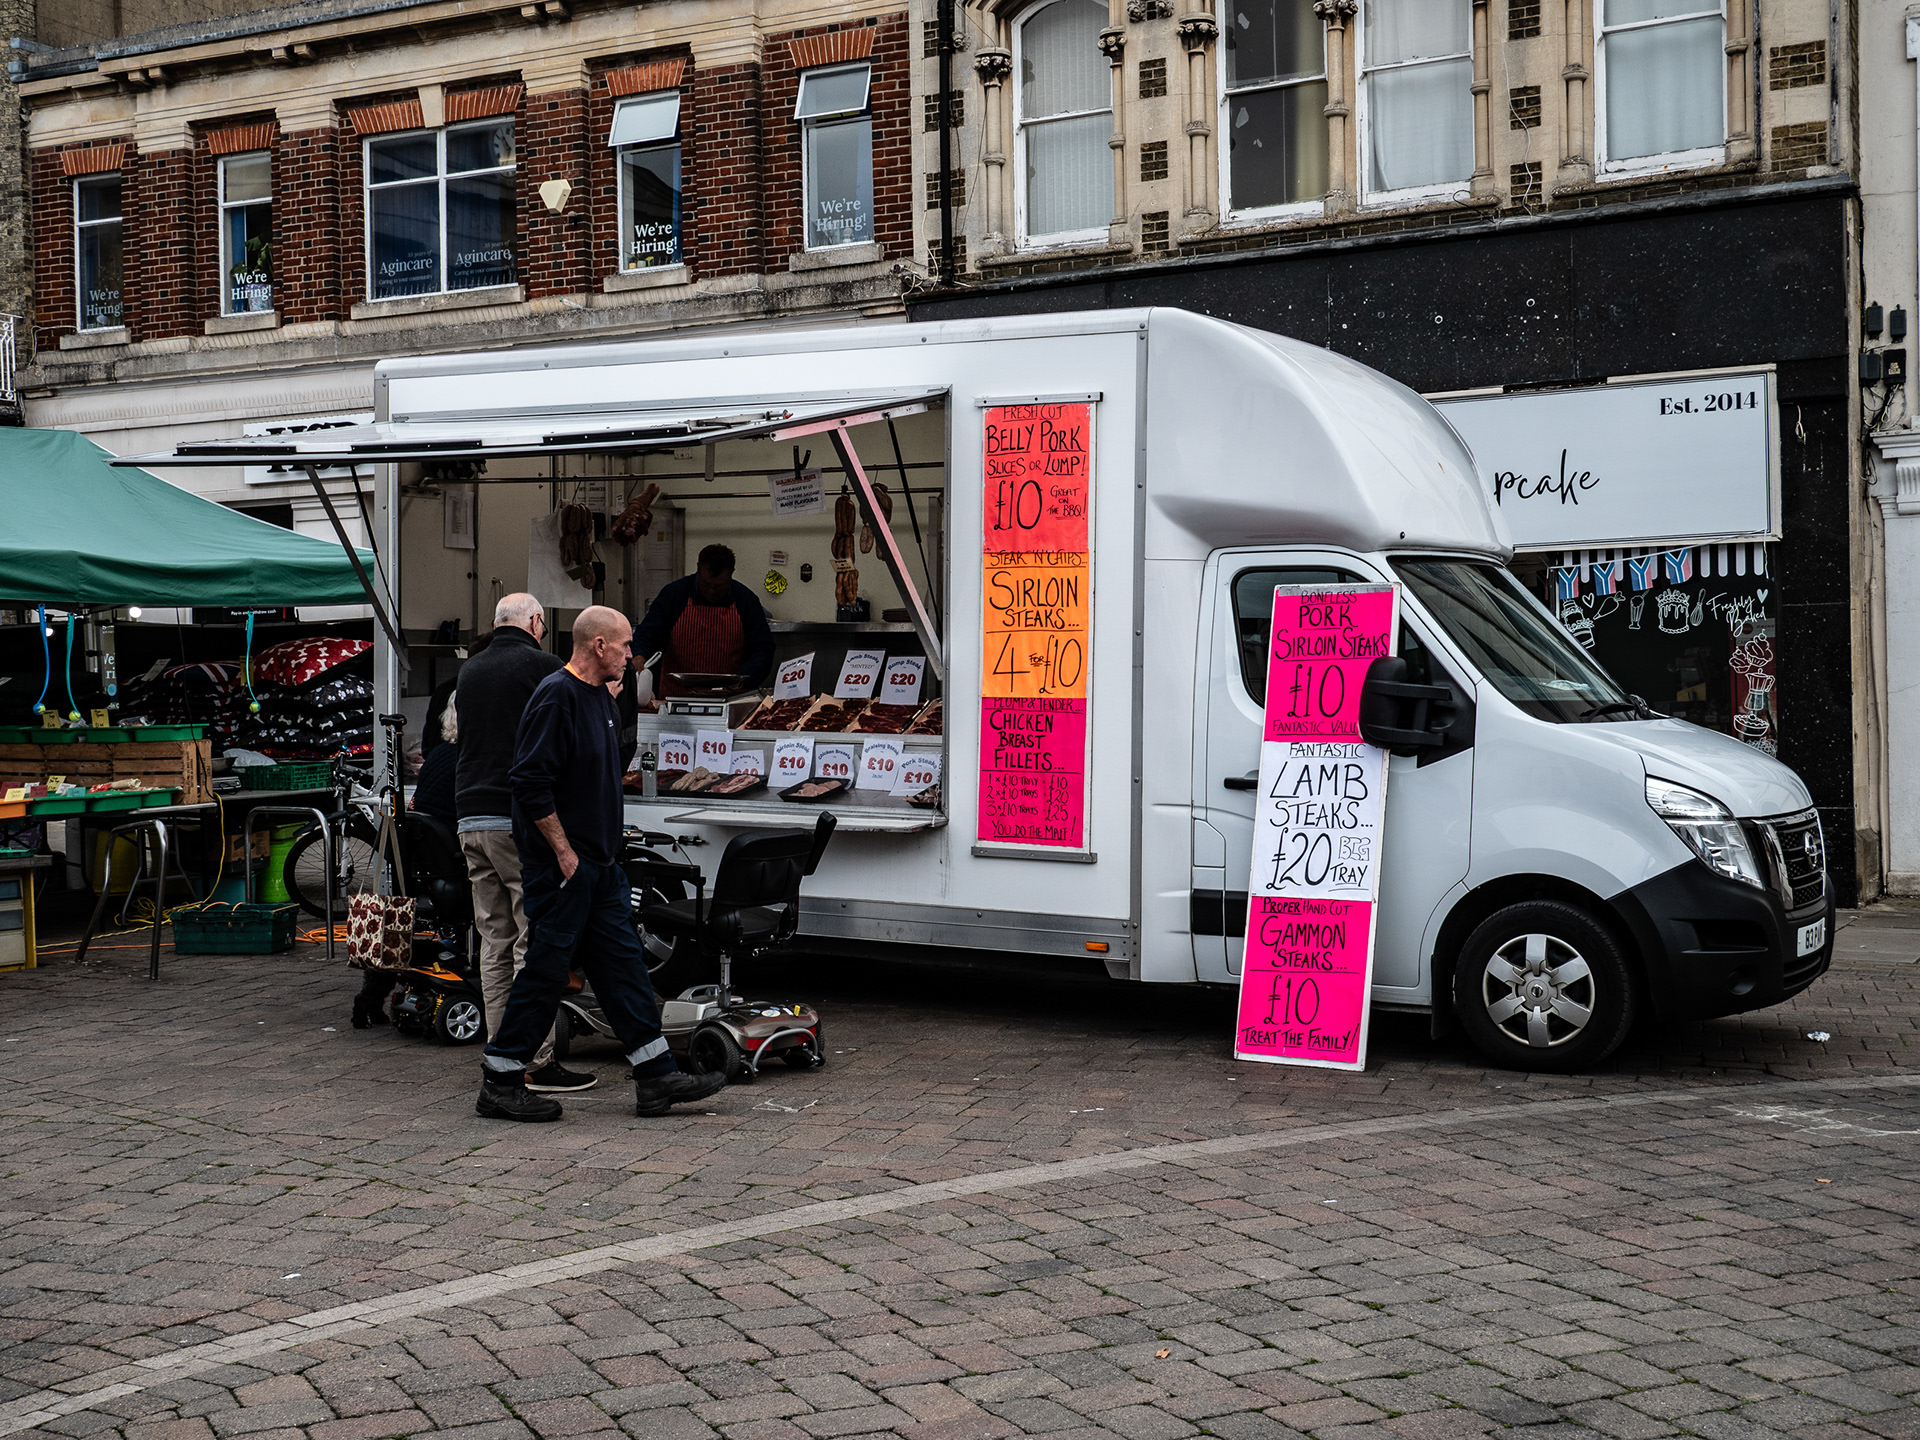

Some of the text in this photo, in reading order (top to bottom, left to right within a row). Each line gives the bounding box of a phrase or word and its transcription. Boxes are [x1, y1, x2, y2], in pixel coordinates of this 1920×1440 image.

[820, 197, 861, 214] We're
[634, 221, 673, 238] We're
[816, 212, 867, 232] Hiring!
[630, 236, 677, 255] Hiring!
[455, 248, 512, 267] Agincare
[379, 258, 433, 277] Agincare
[235, 270, 268, 285] We're
[89, 287, 120, 301] We're
[231, 284, 272, 301] Hiring!
[86, 301, 124, 317] Hiring!
[1003, 404, 1066, 419] FRESH CUT
[1658, 391, 1759, 416] Est. 2014
[986, 420, 1086, 453] BELLY PORK
[987, 453, 1086, 476] SLICES OR LUMP!
[1050, 485, 1080, 498] GREAT
[994, 480, 1042, 530] £10
[990, 550, 1027, 566] STEAK
[990, 571, 1077, 610] SIRLOIN
[1301, 590, 1357, 604] BONELESS
[1706, 592, 1755, 620] Freshly
[1003, 608, 1079, 629] STEAKS...
[1299, 605, 1359, 628] PORK
[1726, 606, 1766, 637] Baked
[1275, 627, 1389, 659] SIRLOIN STEAKS
[888, 660, 904, 670] Rump
[993, 634, 1082, 694] 4 FOR £10
[782, 669, 805, 683] £20
[844, 673, 871, 685] £20
[890, 673, 916, 685] £20
[1287, 664, 1345, 718] £10
[994, 697, 1027, 708] PLUMP
[990, 710, 1053, 732] CHICKEN
[1273, 720, 1357, 734] FANTASTIC VALU
[661, 739, 681, 748] Chinese
[702, 741, 726, 754] £10
[998, 731, 1046, 749] BREAST
[665, 751, 688, 765] £10
[818, 750, 834, 760] Chicken
[1290, 743, 1366, 758] FANTASTIC
[779, 756, 805, 769] £10
[867, 757, 894, 771] £10
[901, 758, 916, 769] Pork
[995, 748, 1064, 771] FILLETS...
[823, 763, 848, 776] £10
[904, 771, 933, 784] £10
[1019, 777, 1038, 787] TRAY
[1049, 775, 1068, 790] £10
[1270, 761, 1368, 800] LAMB
[1046, 789, 1069, 804] £20
[1045, 803, 1068, 821] £25
[1270, 800, 1373, 829] STEAKS...
[992, 820, 1011, 835] YOU
[1014, 825, 1026, 836] DO
[1027, 825, 1042, 837] THE
[1338, 836, 1371, 861] BIG
[1266, 827, 1332, 890] £20
[1330, 863, 1368, 887] TRAY
[1303, 900, 1327, 915] HAND
[1330, 900, 1353, 915] CUT
[1260, 915, 1346, 953] GAMMON
[1271, 948, 1347, 971] STEAKS...
[1263, 975, 1320, 1025] £10
[1241, 1023, 1360, 1051] TREAT THE FAMILY!
